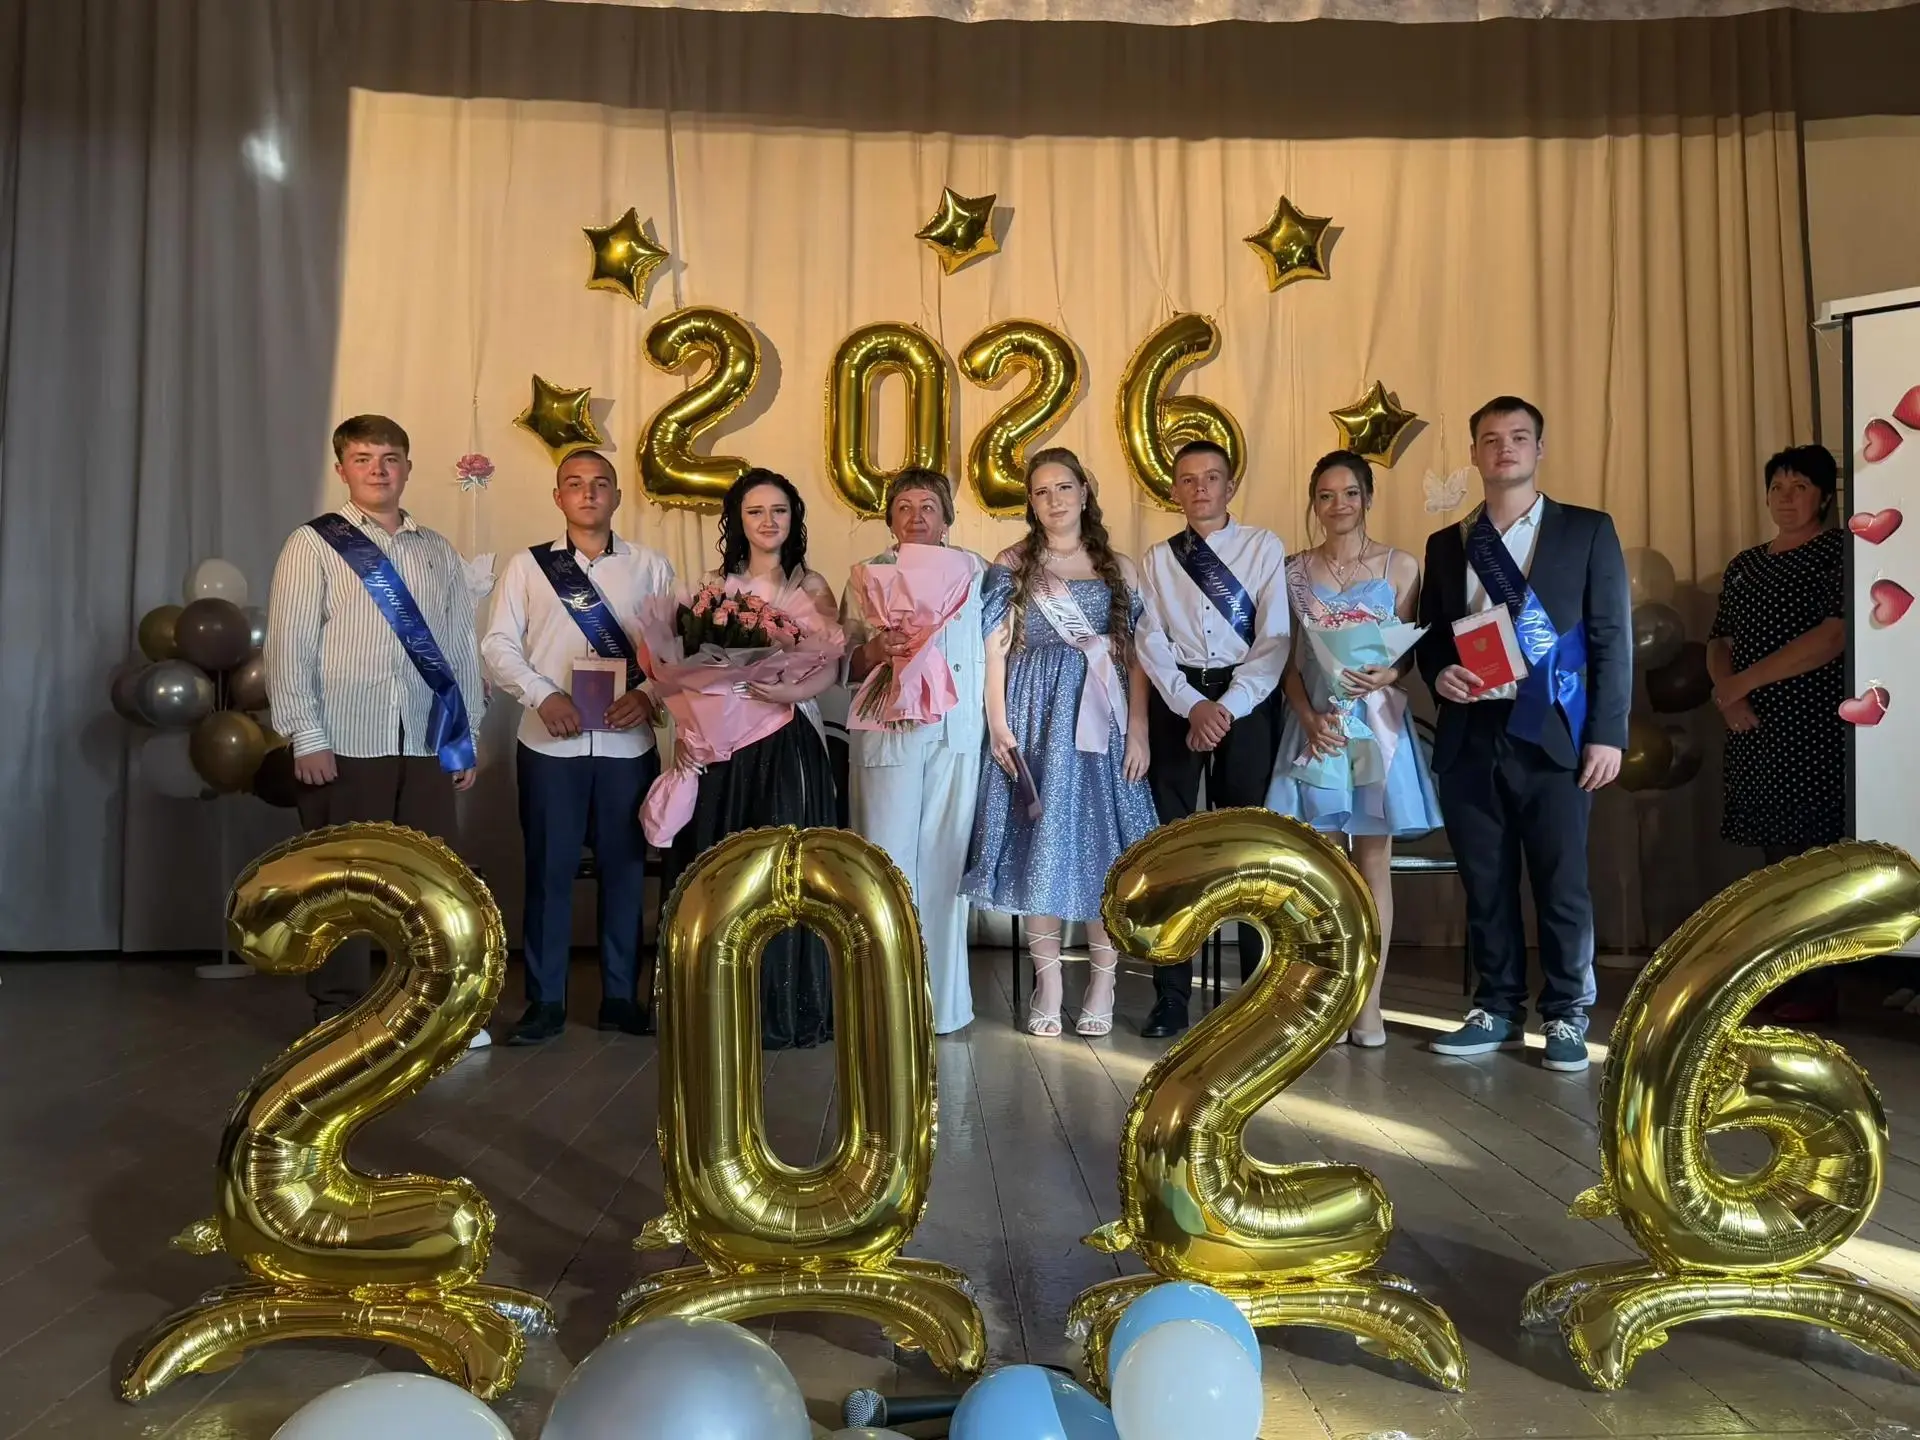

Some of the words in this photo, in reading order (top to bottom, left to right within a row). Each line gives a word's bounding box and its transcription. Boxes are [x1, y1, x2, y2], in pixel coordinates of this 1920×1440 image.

[637, 305, 1247, 518] 2026
[346, 538, 414, 627] Выпускник
[218, 806, 1920, 1284] 2026
